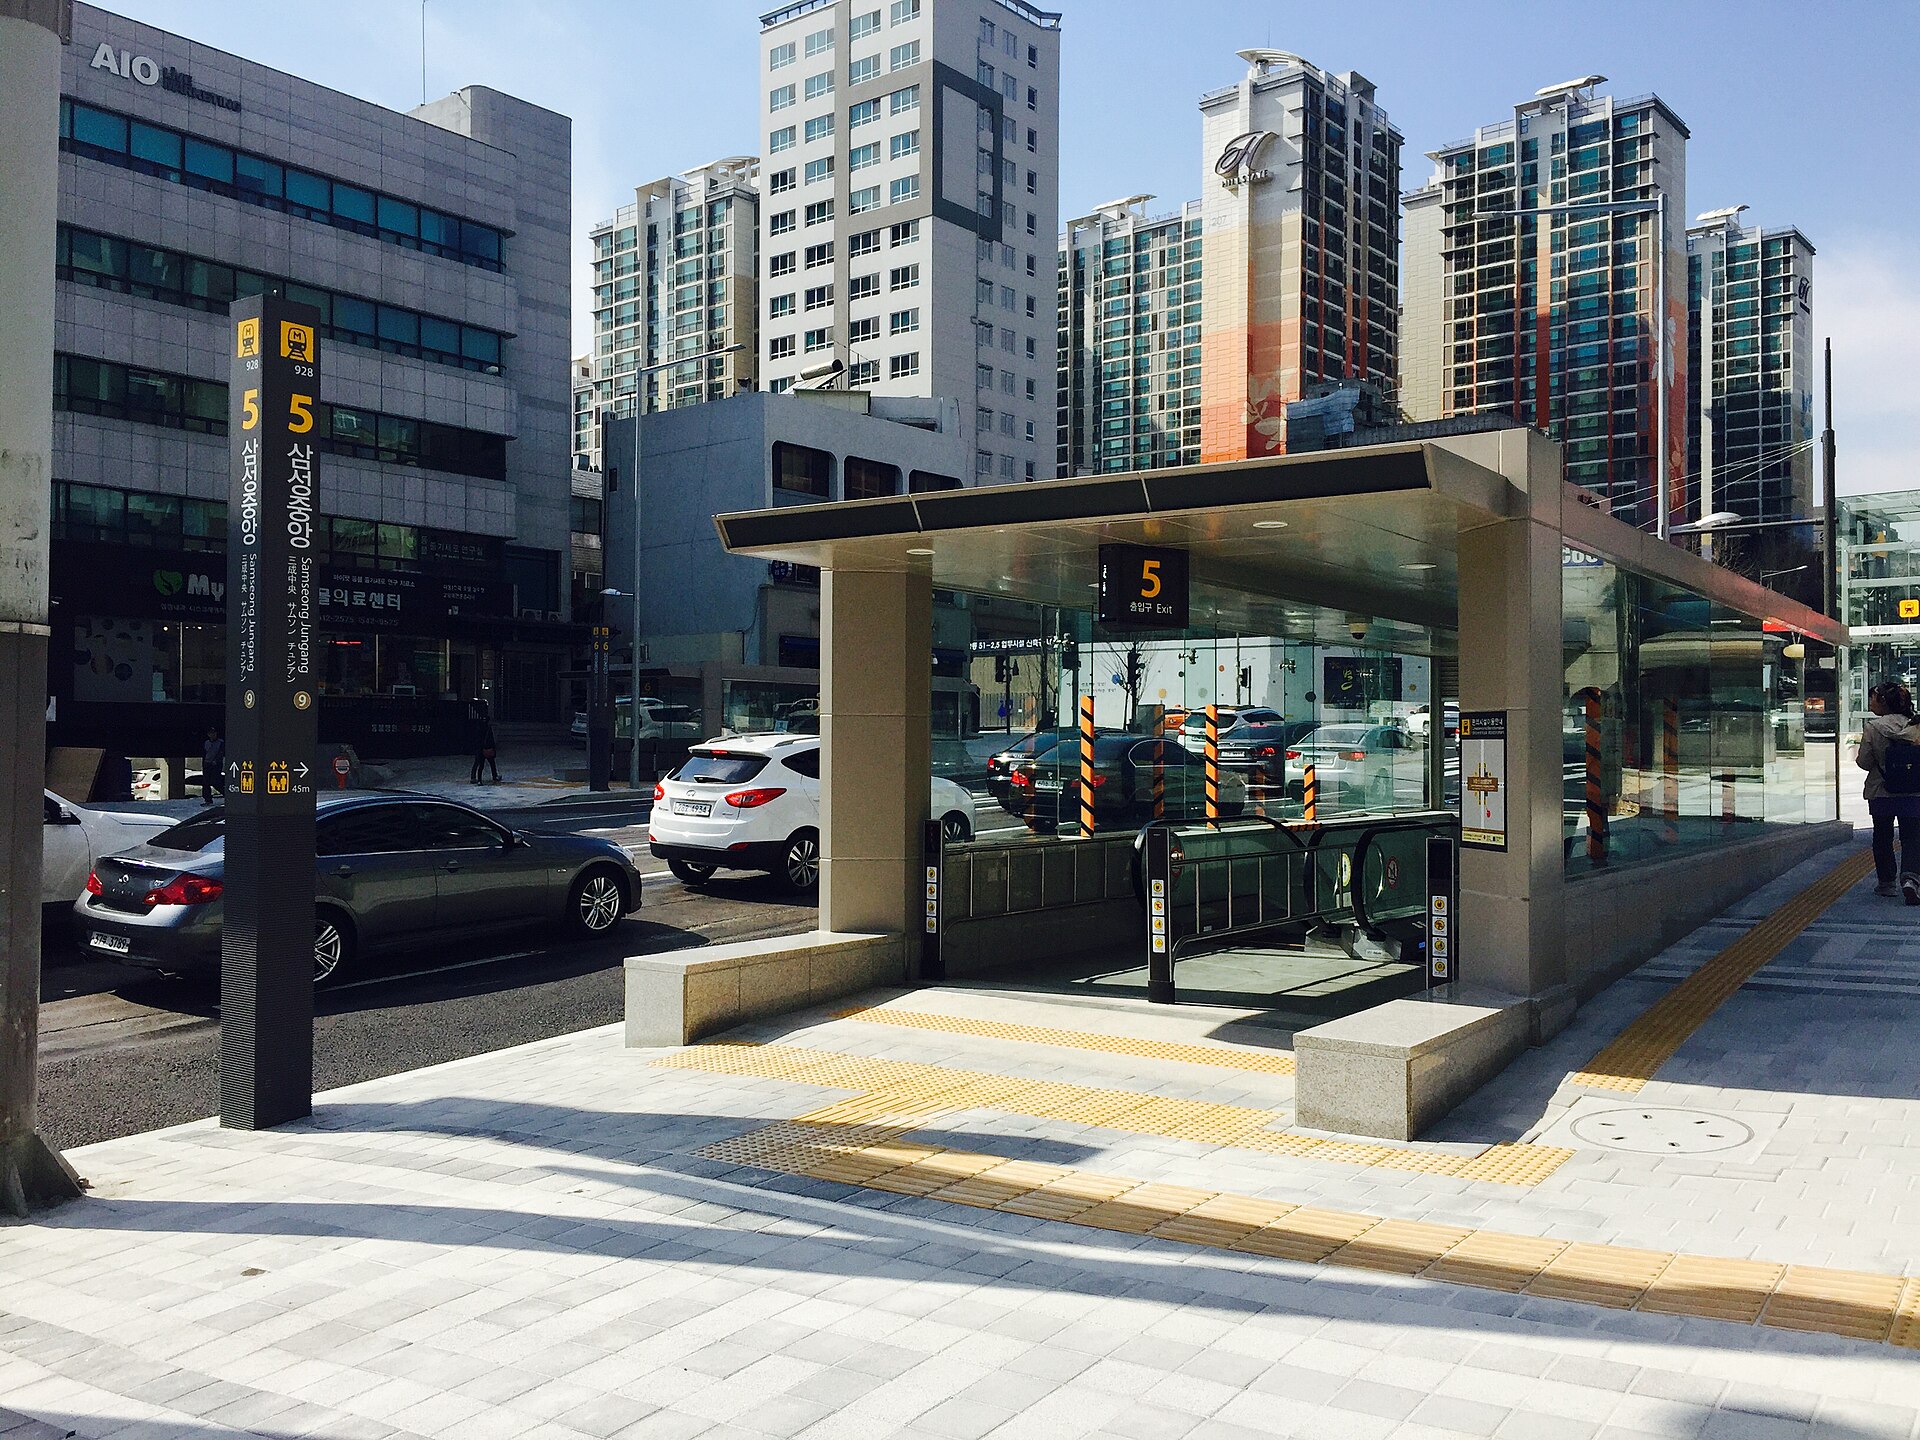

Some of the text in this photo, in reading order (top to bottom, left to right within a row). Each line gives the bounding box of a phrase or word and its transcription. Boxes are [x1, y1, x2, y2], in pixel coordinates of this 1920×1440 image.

[90, 43, 160, 86] AIO
[246, 359, 259, 371] 928
[294, 364, 314, 378] 928
[241, 388, 259, 431] 5
[287, 393, 314, 434] 5
[240, 438, 259, 546] 삼성중앙
[286, 442, 314, 549] 삼성중앙
[287, 555, 298, 595] 三成中央
[1140, 559, 1162, 599] 5
[246, 553, 258, 672] Samseong Jungang
[297, 557, 313, 674] Samseong Jungang
[1129, 601, 1173, 615] 출입구 Exit
[286, 601, 297, 683] サムソン チュンアン
[602, 641, 609, 652] 6
[292, 785, 310, 793] 45m
